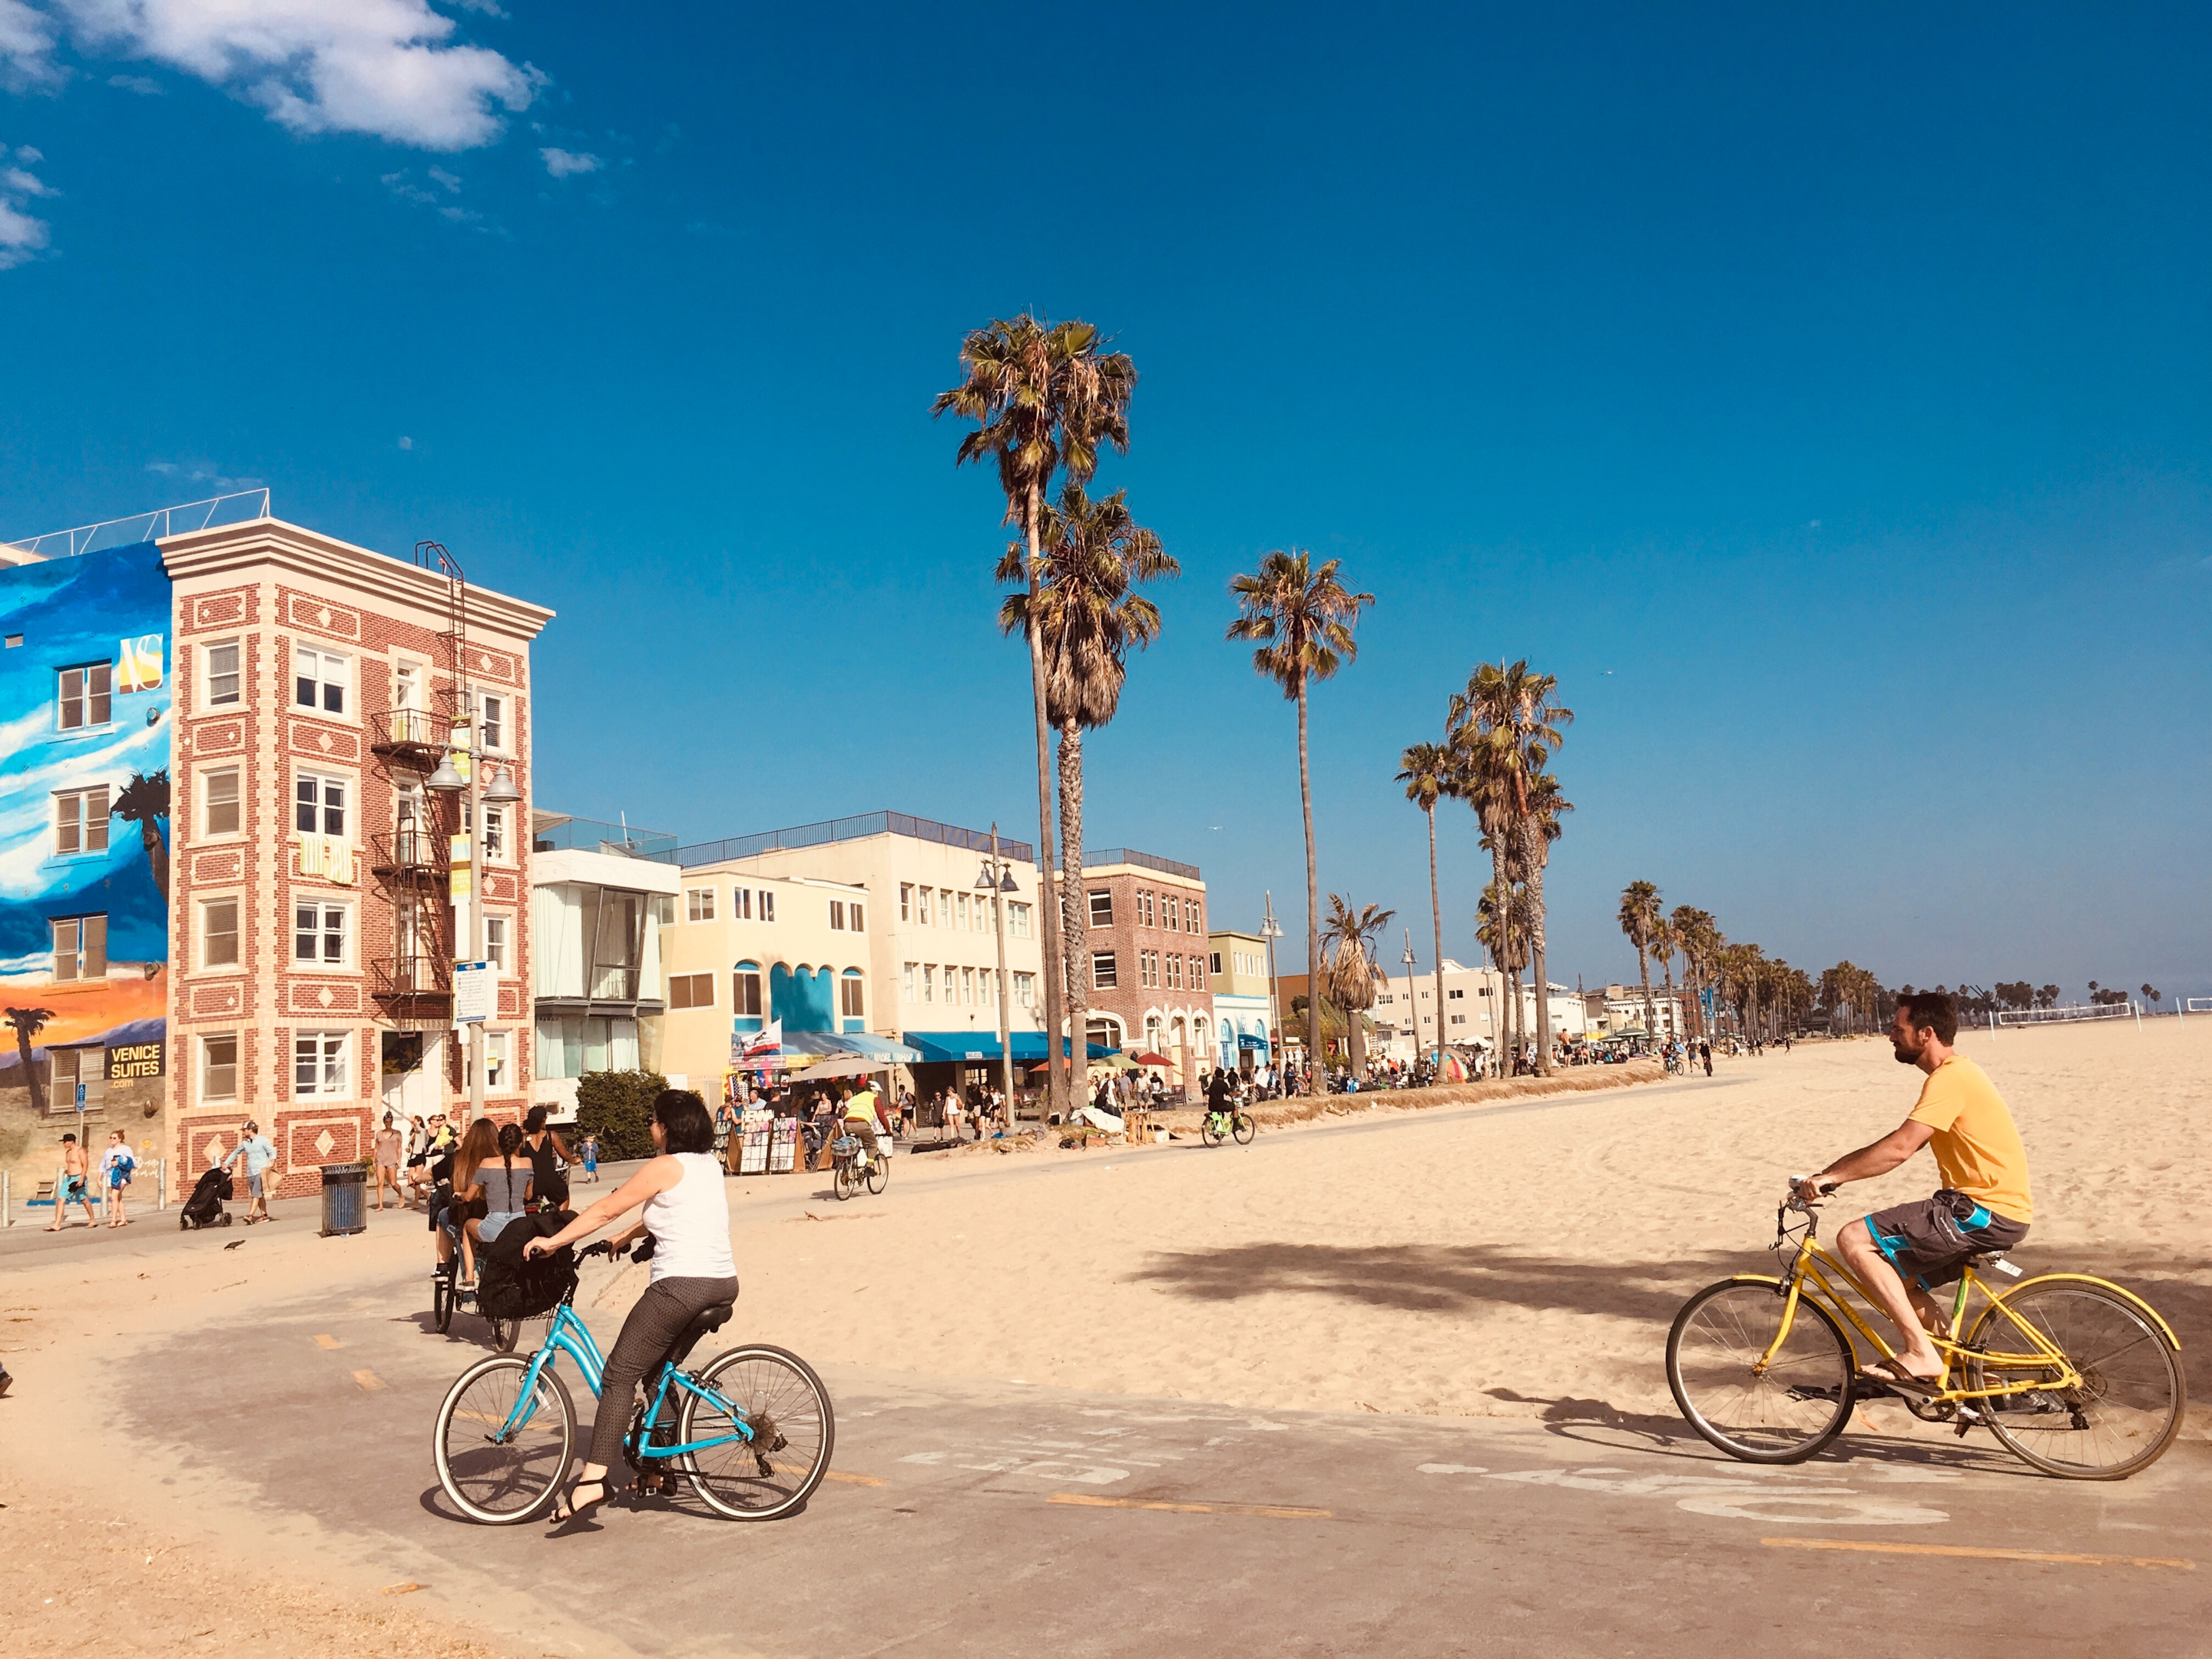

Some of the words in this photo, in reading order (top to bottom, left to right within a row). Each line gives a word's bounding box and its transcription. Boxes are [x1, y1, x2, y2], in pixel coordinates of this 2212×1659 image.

[120, 634, 164, 693] VS
[111, 1045, 160, 1061] VENICE
[897, 1053, 913, 1062] SHOP
[111, 1061, 159, 1078] SUITES
[111, 1079, 134, 1088] .com
[741, 1109, 775, 1123] HENNA
[1838, 1300, 1865, 1330] ELECTRA
